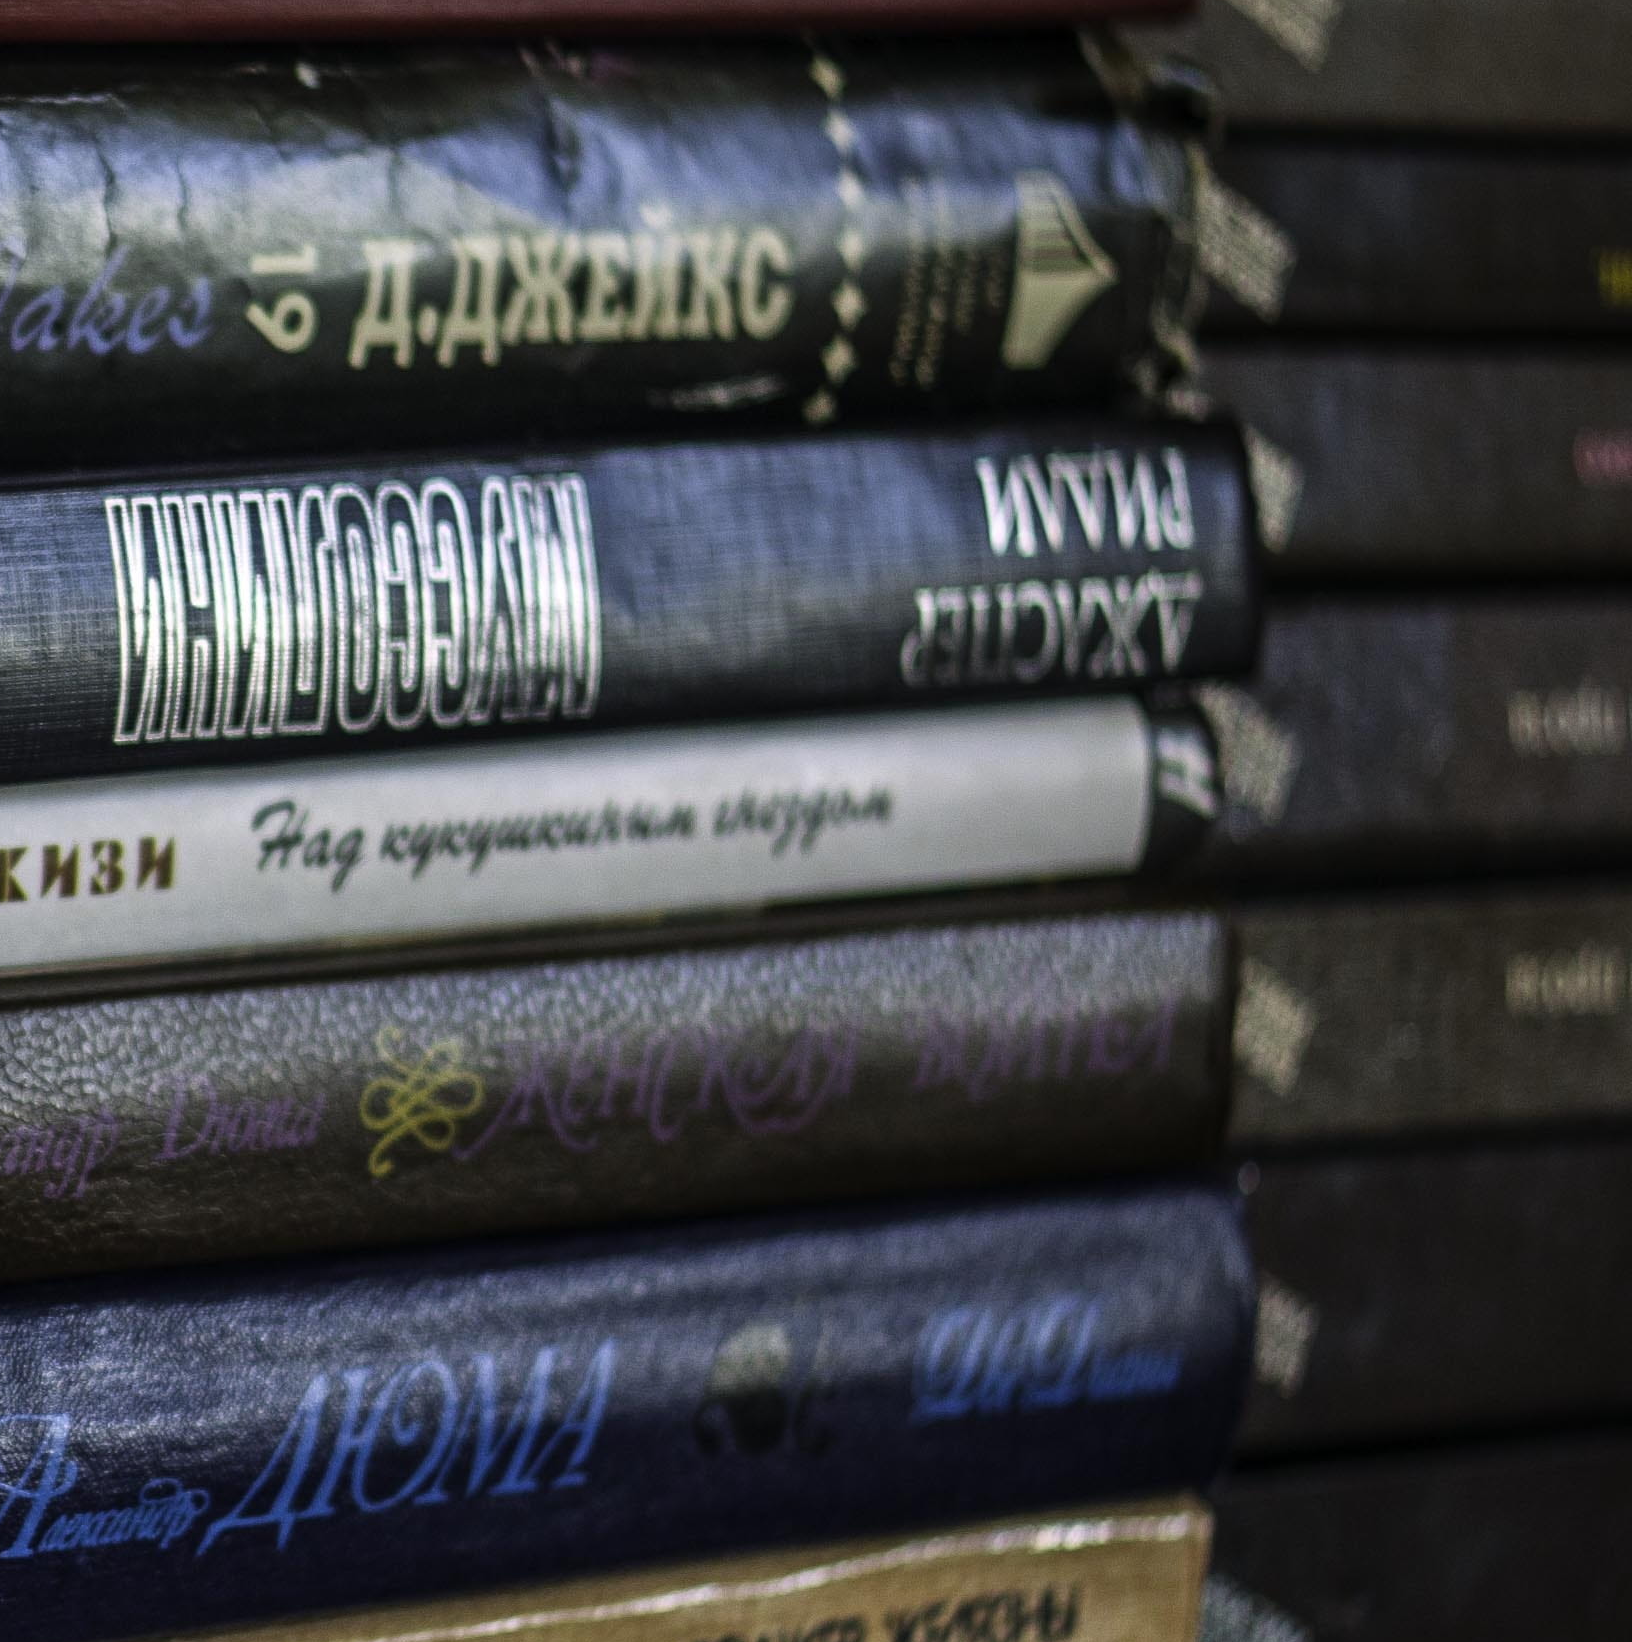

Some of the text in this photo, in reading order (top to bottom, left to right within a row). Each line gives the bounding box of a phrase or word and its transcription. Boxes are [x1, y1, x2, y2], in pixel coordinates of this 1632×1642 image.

[245, 244, 318, 353] 19
[974, 451, 1196, 560] РИДЛИ
[105, 472, 603, 745] МУССОЛИНИ
[902, 572, 1202, 688] ДЖАСПЕР
[249, 801, 364, 892] Над
[197, 1334, 616, 1557] ДЮМА
